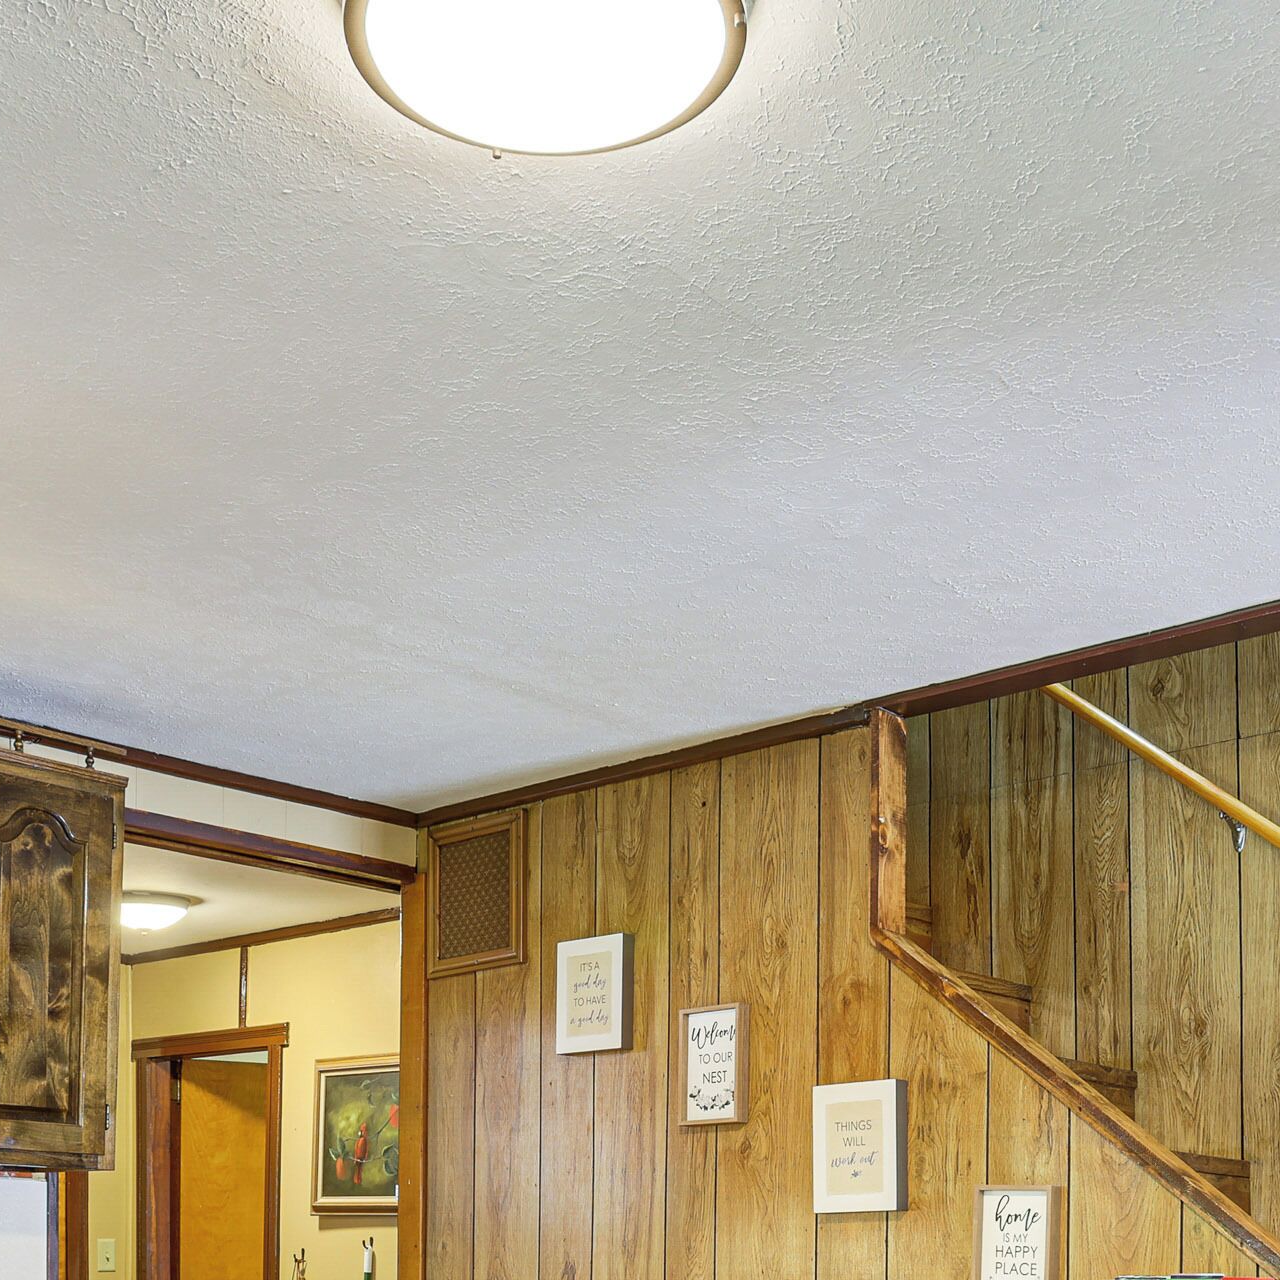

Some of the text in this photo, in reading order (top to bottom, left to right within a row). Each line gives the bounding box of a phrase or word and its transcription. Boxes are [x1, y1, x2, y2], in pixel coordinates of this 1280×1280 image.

[593, 961, 600, 970] A
[573, 973, 607, 993] good day
[573, 995, 606, 1007] TO HAVE
[577, 1009, 595, 1028] good
[595, 1009, 609, 1025] day
[691, 1021, 736, 1050] Welcom
[699, 1051, 733, 1065] TO OUR
[702, 1070, 727, 1084] NEST
[834, 1119, 872, 1132] THINGS
[842, 1136, 866, 1147] WILL
[831, 1151, 879, 1167] work out
[995, 1194, 1041, 1232] home
[1002, 1233, 1029, 1243] IS MY
[995, 1245, 1038, 1259] HAPPY
[995, 1261, 1037, 1276] PLACE
